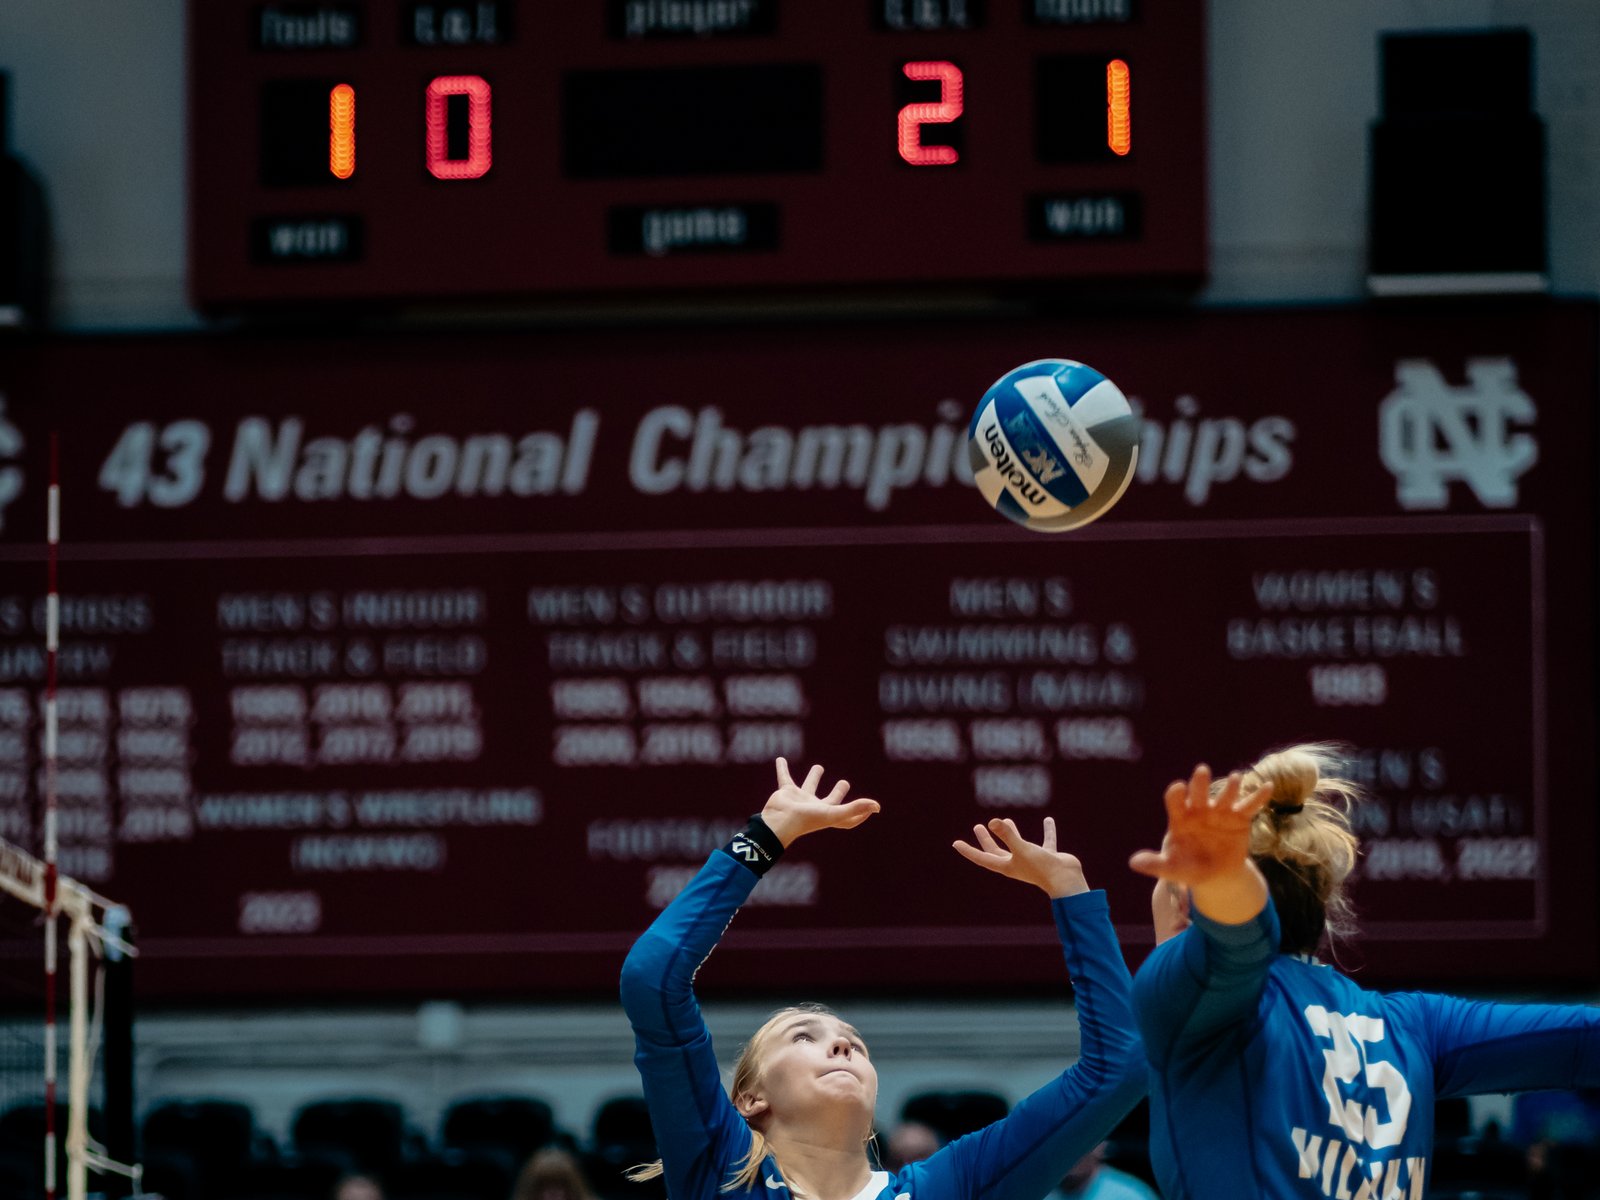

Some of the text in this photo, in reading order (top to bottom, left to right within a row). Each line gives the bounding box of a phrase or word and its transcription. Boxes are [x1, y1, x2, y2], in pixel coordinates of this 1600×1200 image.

[330, 84, 355, 178] 1
[425, 76, 492, 178] 0
[898, 61, 963, 165] 2
[1107, 60, 1131, 155] 1
[100, 421, 209, 507] 43
[223, 408, 600, 502] National
[628, 404, 1296, 512] Champihips
[984, 423, 1047, 506] molten
